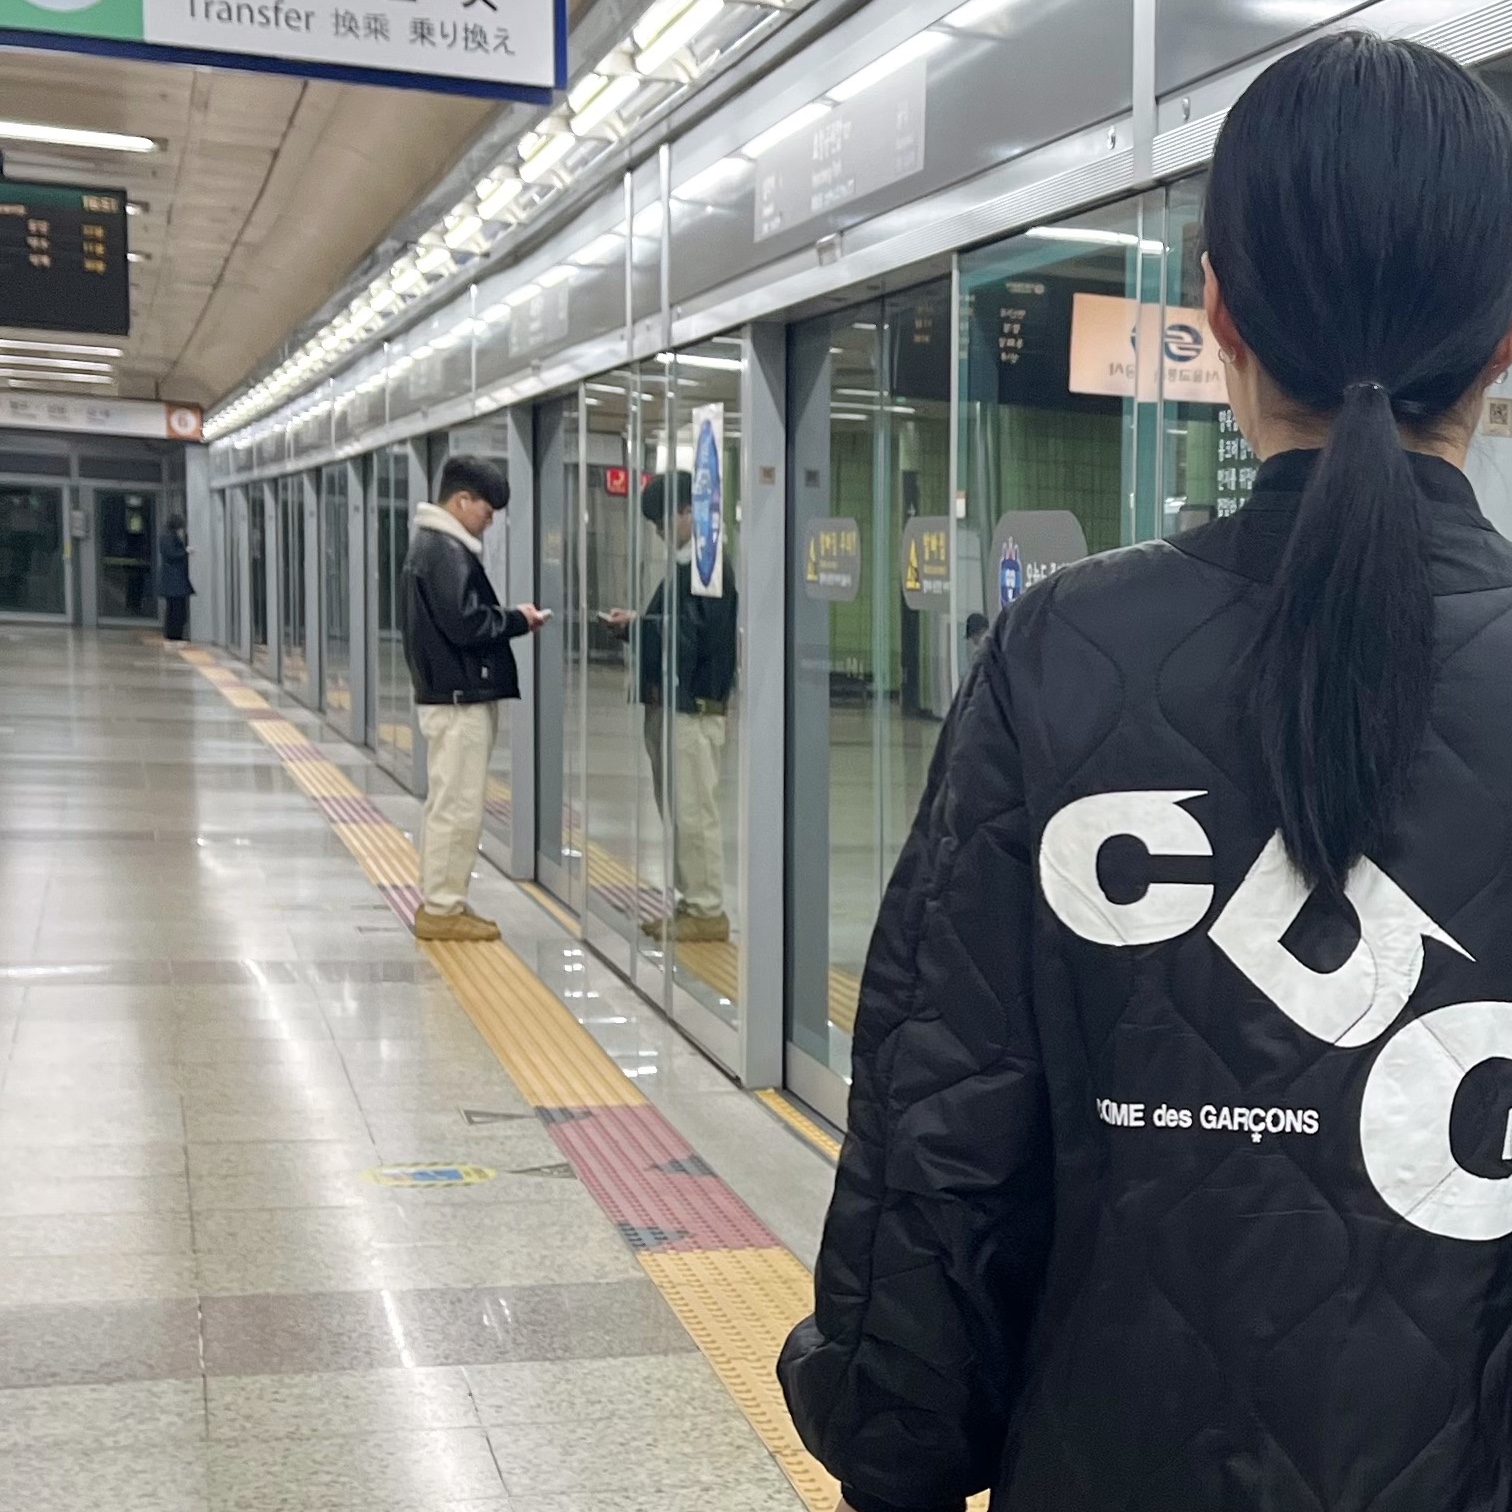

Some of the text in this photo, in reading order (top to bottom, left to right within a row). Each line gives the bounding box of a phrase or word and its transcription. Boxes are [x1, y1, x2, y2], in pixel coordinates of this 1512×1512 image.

[187, 0, 315, 33] Transfer
[1152, 1103, 1193, 1128] des
[1199, 1103, 1320, 1144] GARÇONS
